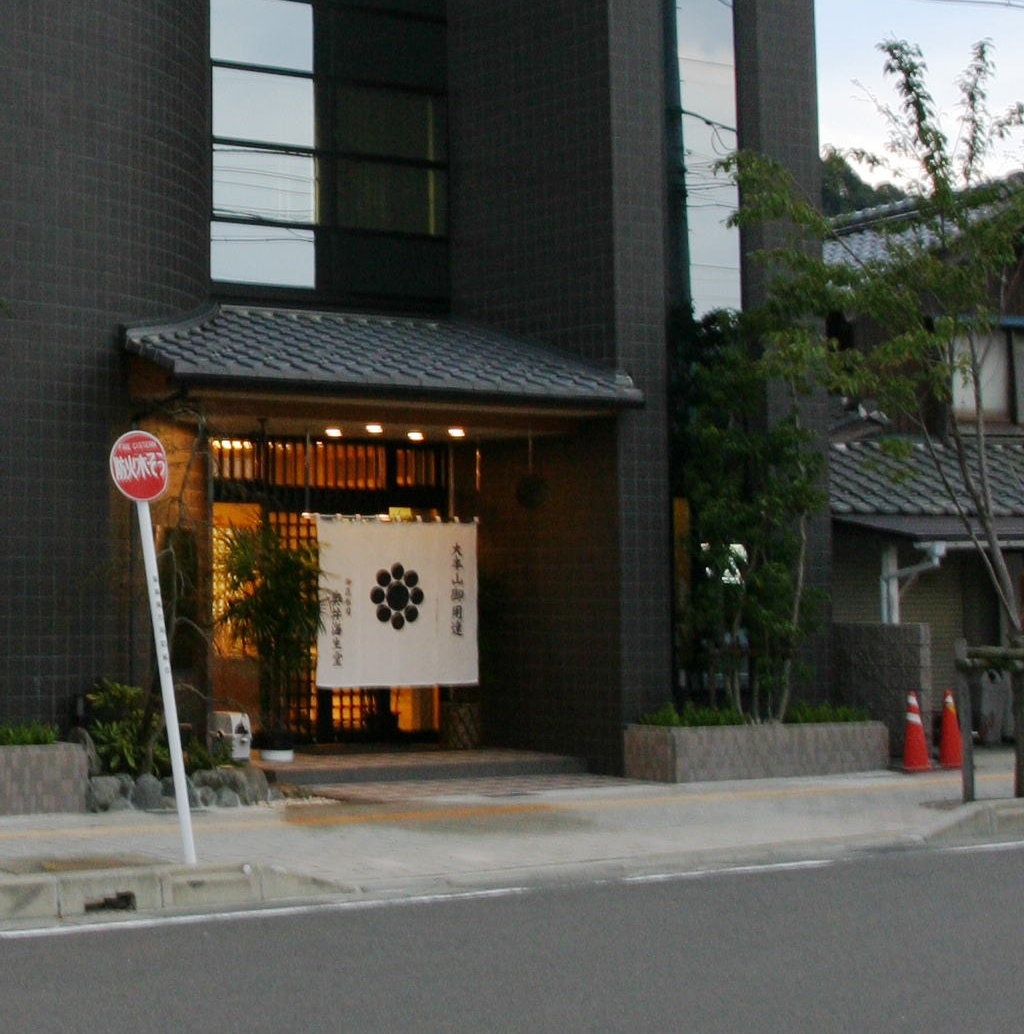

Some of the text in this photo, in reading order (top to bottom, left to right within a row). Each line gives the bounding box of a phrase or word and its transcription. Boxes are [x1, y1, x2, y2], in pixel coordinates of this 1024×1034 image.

[113, 452, 165, 481] 防火水そう
